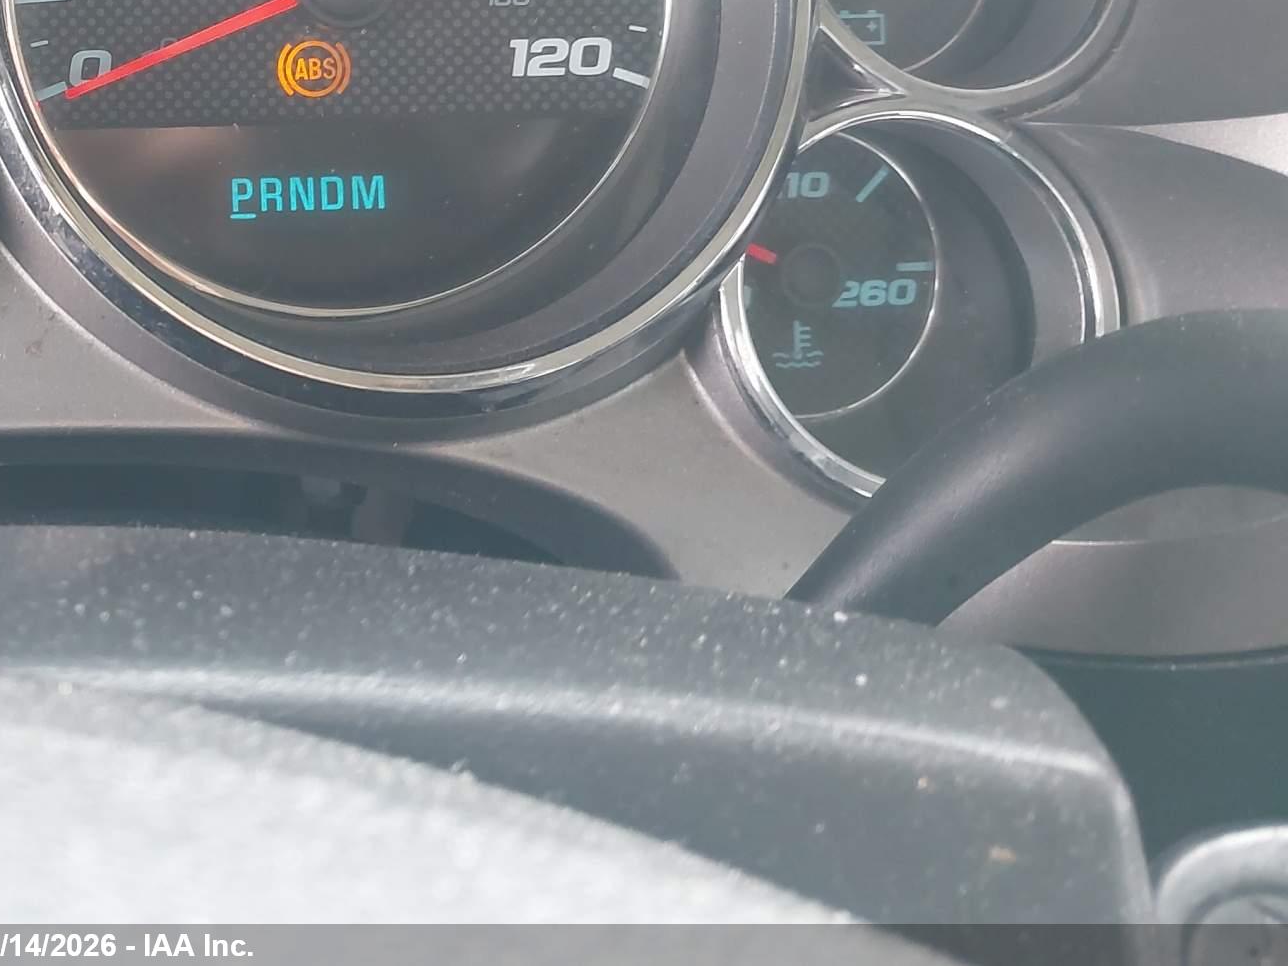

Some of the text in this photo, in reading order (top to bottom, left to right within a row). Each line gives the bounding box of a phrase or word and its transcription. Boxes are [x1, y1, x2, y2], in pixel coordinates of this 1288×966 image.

[69, 50, 112, 87] 0
[294, 57, 336, 80] ABS
[510, 38, 611, 77] 120
[778, 171, 830, 198] 10
[832, 279, 916, 307] 260
